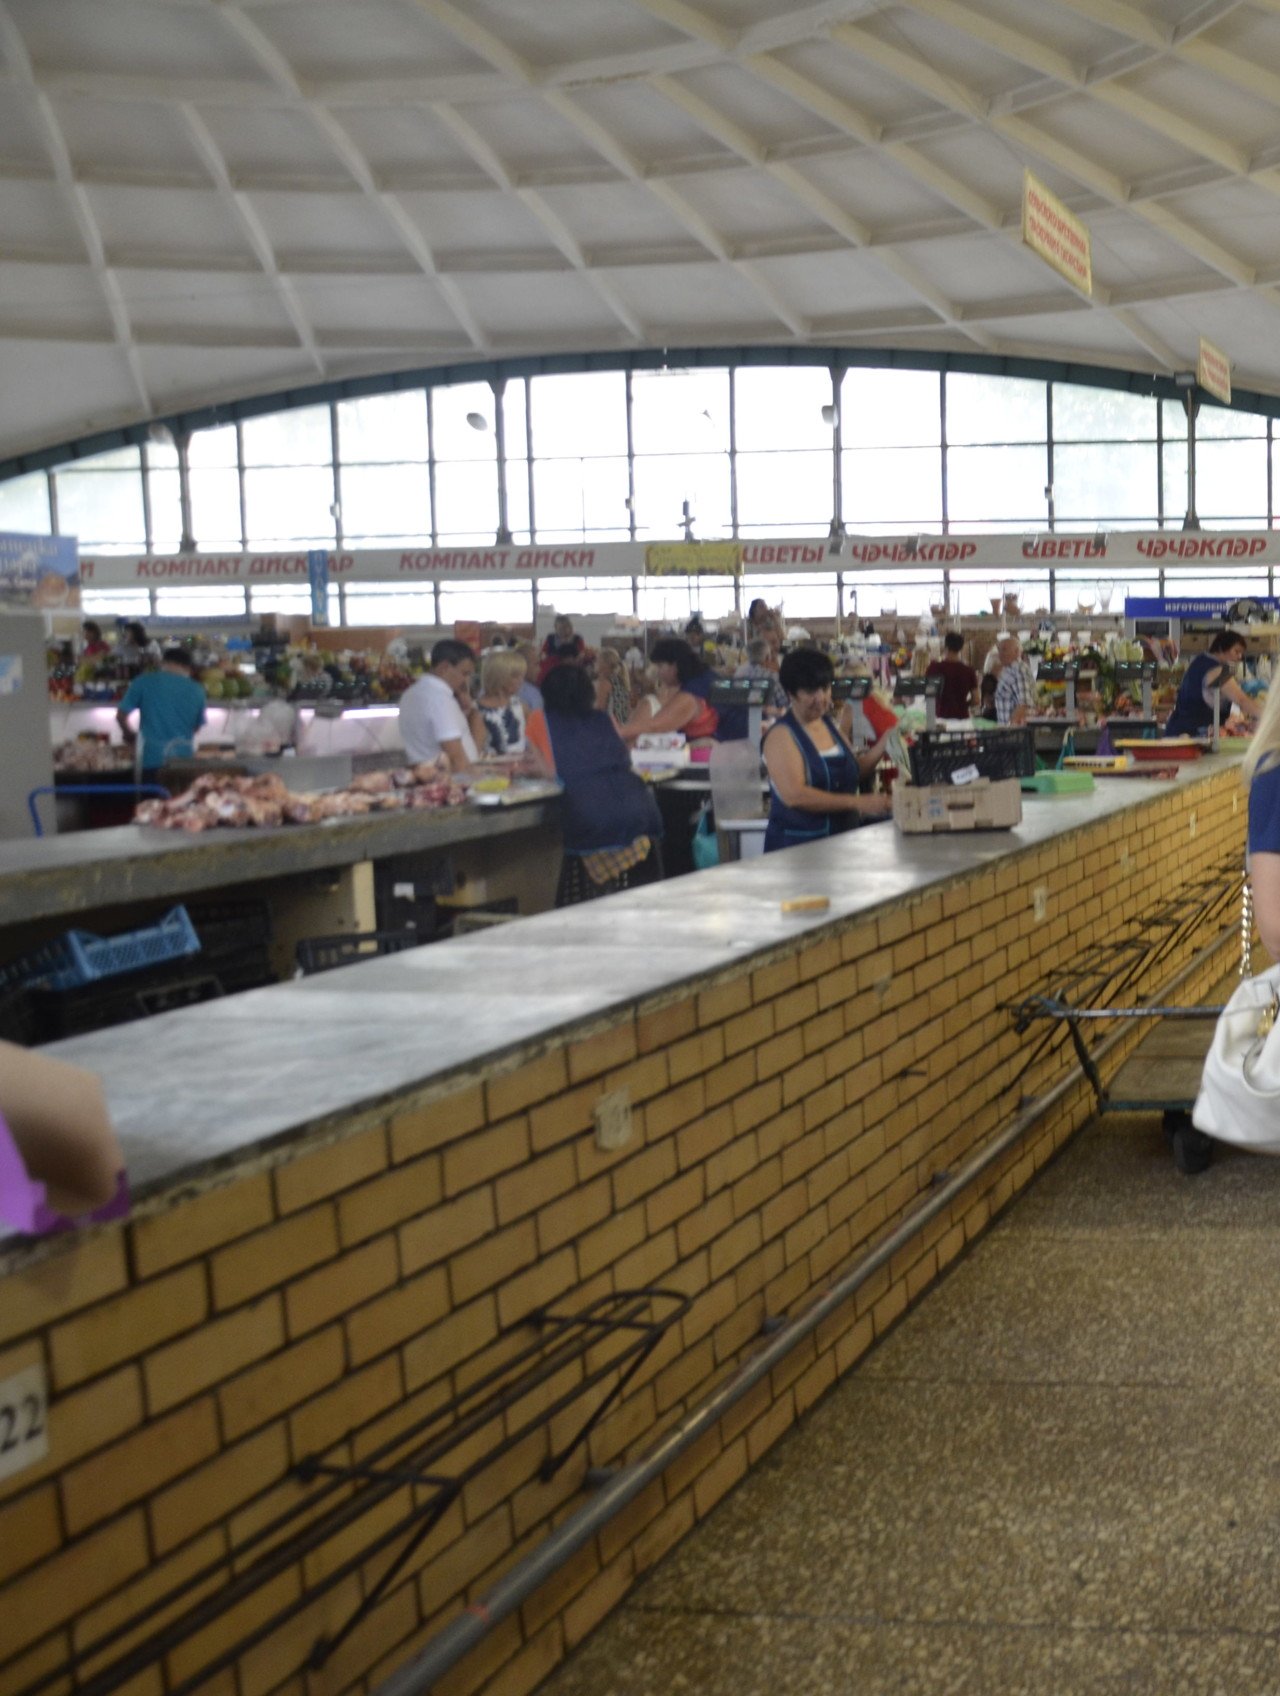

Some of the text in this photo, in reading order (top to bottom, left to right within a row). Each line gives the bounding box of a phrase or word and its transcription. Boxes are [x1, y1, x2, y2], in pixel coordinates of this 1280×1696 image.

[742, 543, 824, 564] ЦВЕТЫ
[1022, 538, 1107, 559] ЦВЕТЫ
[136, 554, 354, 578] КОМПАКТ ДИСКАР
[400, 549, 595, 571] КОМПАКТ ДИСКИ
